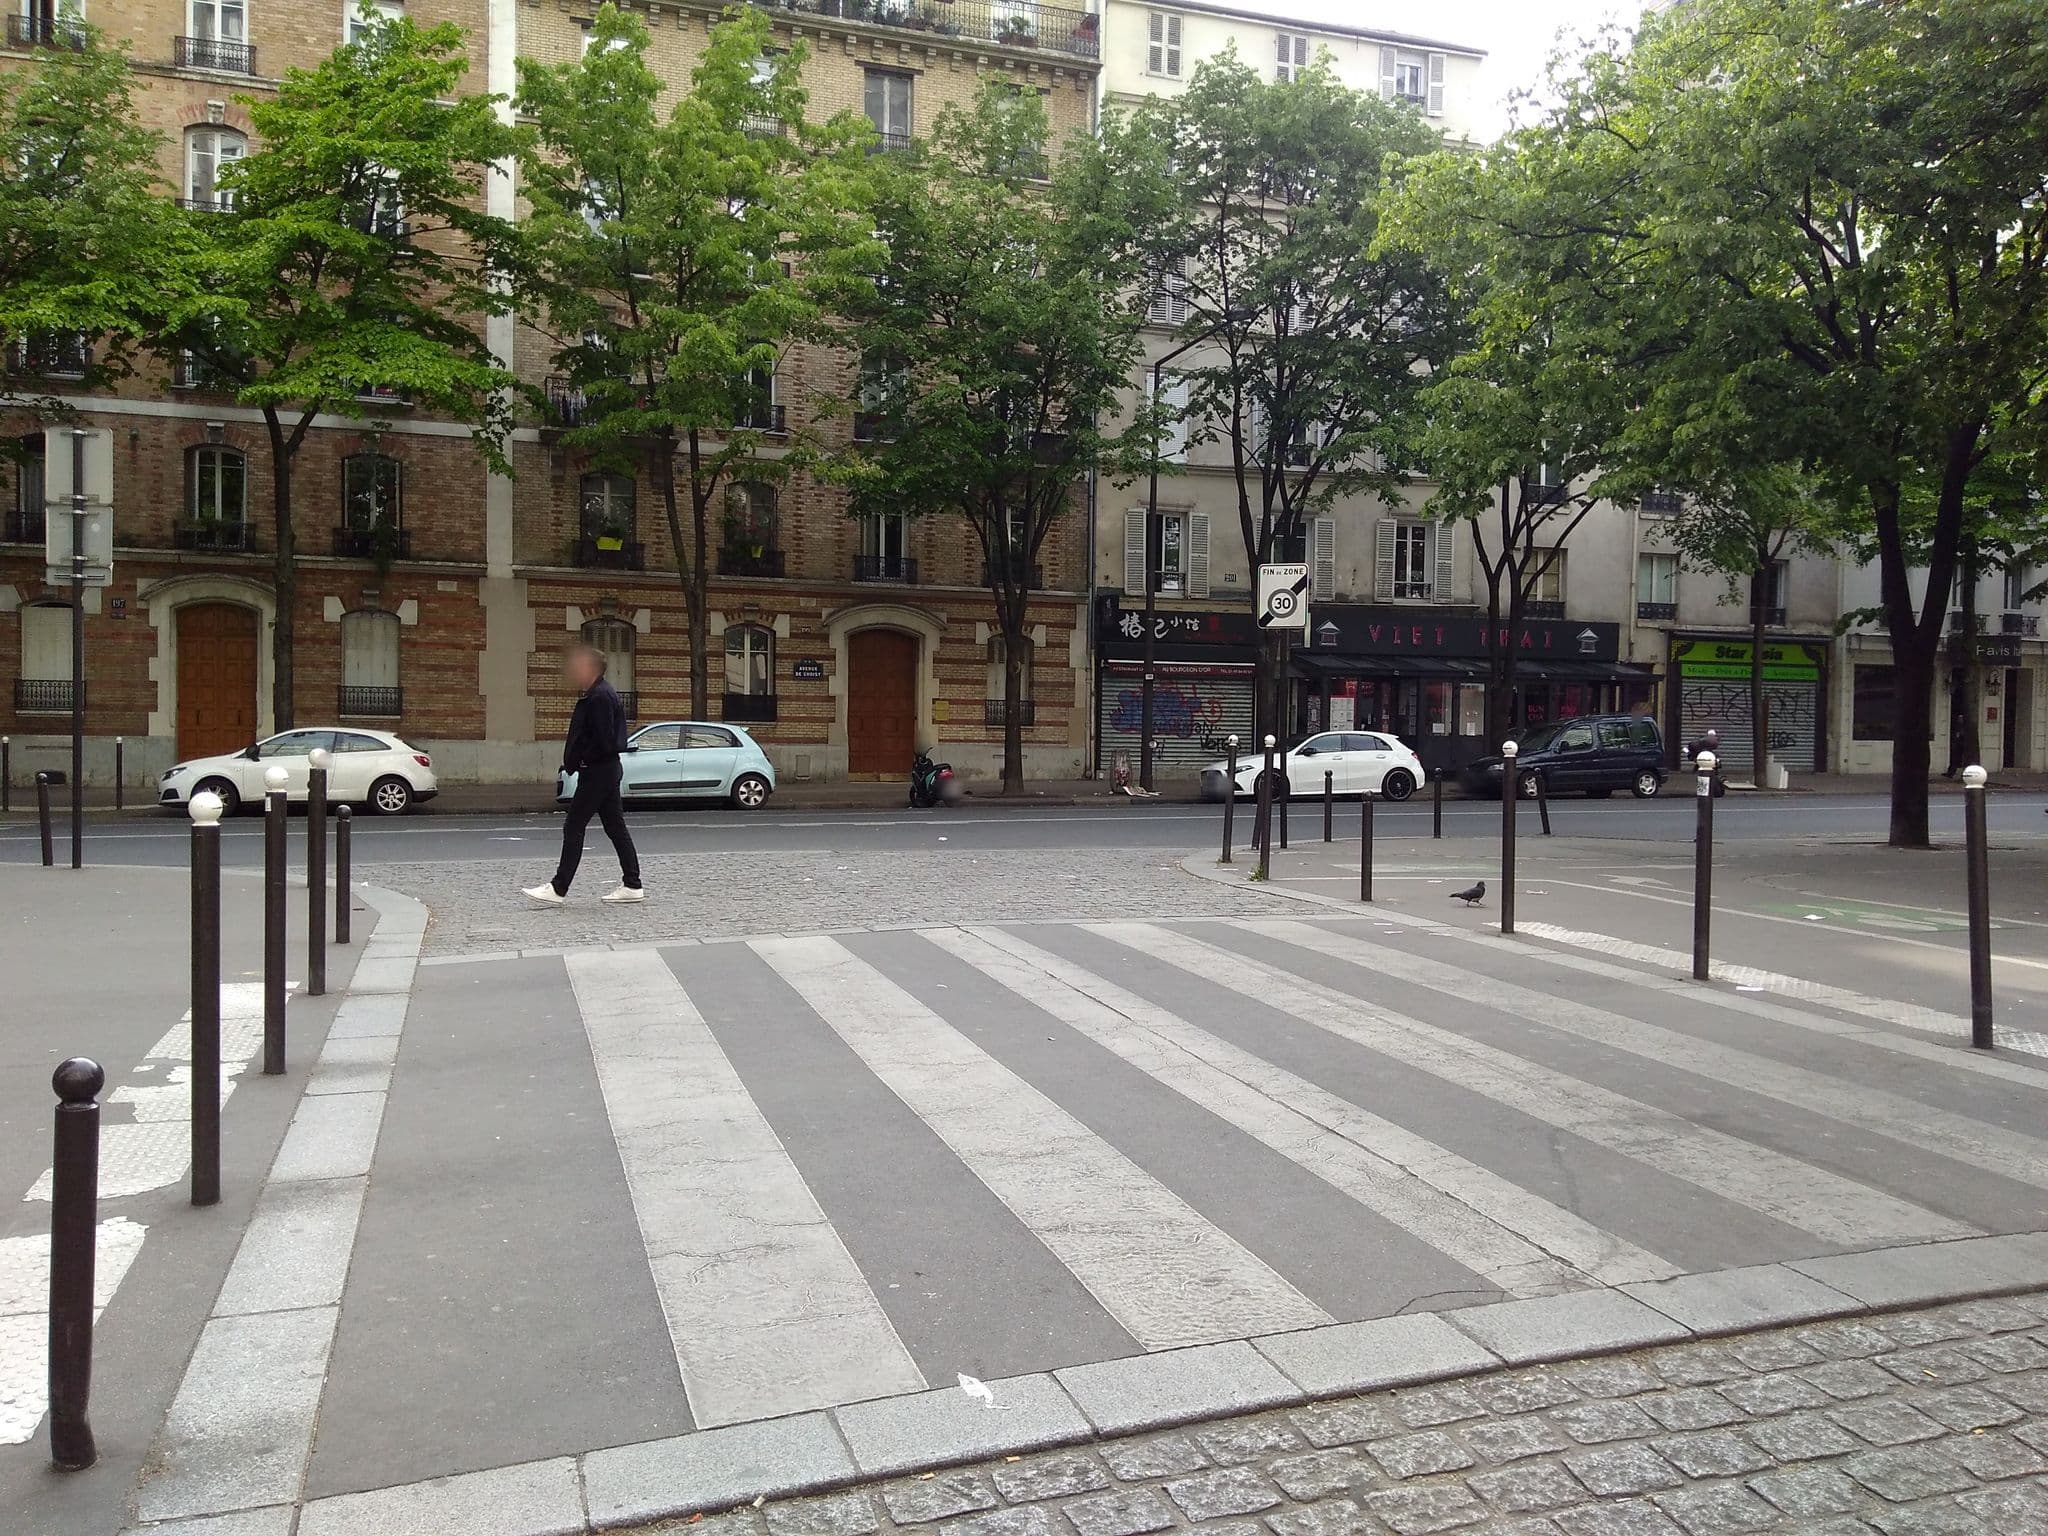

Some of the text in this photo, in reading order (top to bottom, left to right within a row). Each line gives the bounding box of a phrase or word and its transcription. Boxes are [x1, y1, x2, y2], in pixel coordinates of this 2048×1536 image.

[1284, 567, 1305, 575] ZONE
[1225, 574, 1236, 582] 201
[112, 599, 126, 608] 197
[1274, 597, 1291, 610] 30
[1368, 623, 1553, 649] VIET THAI
[1715, 645, 1747, 660] Star
